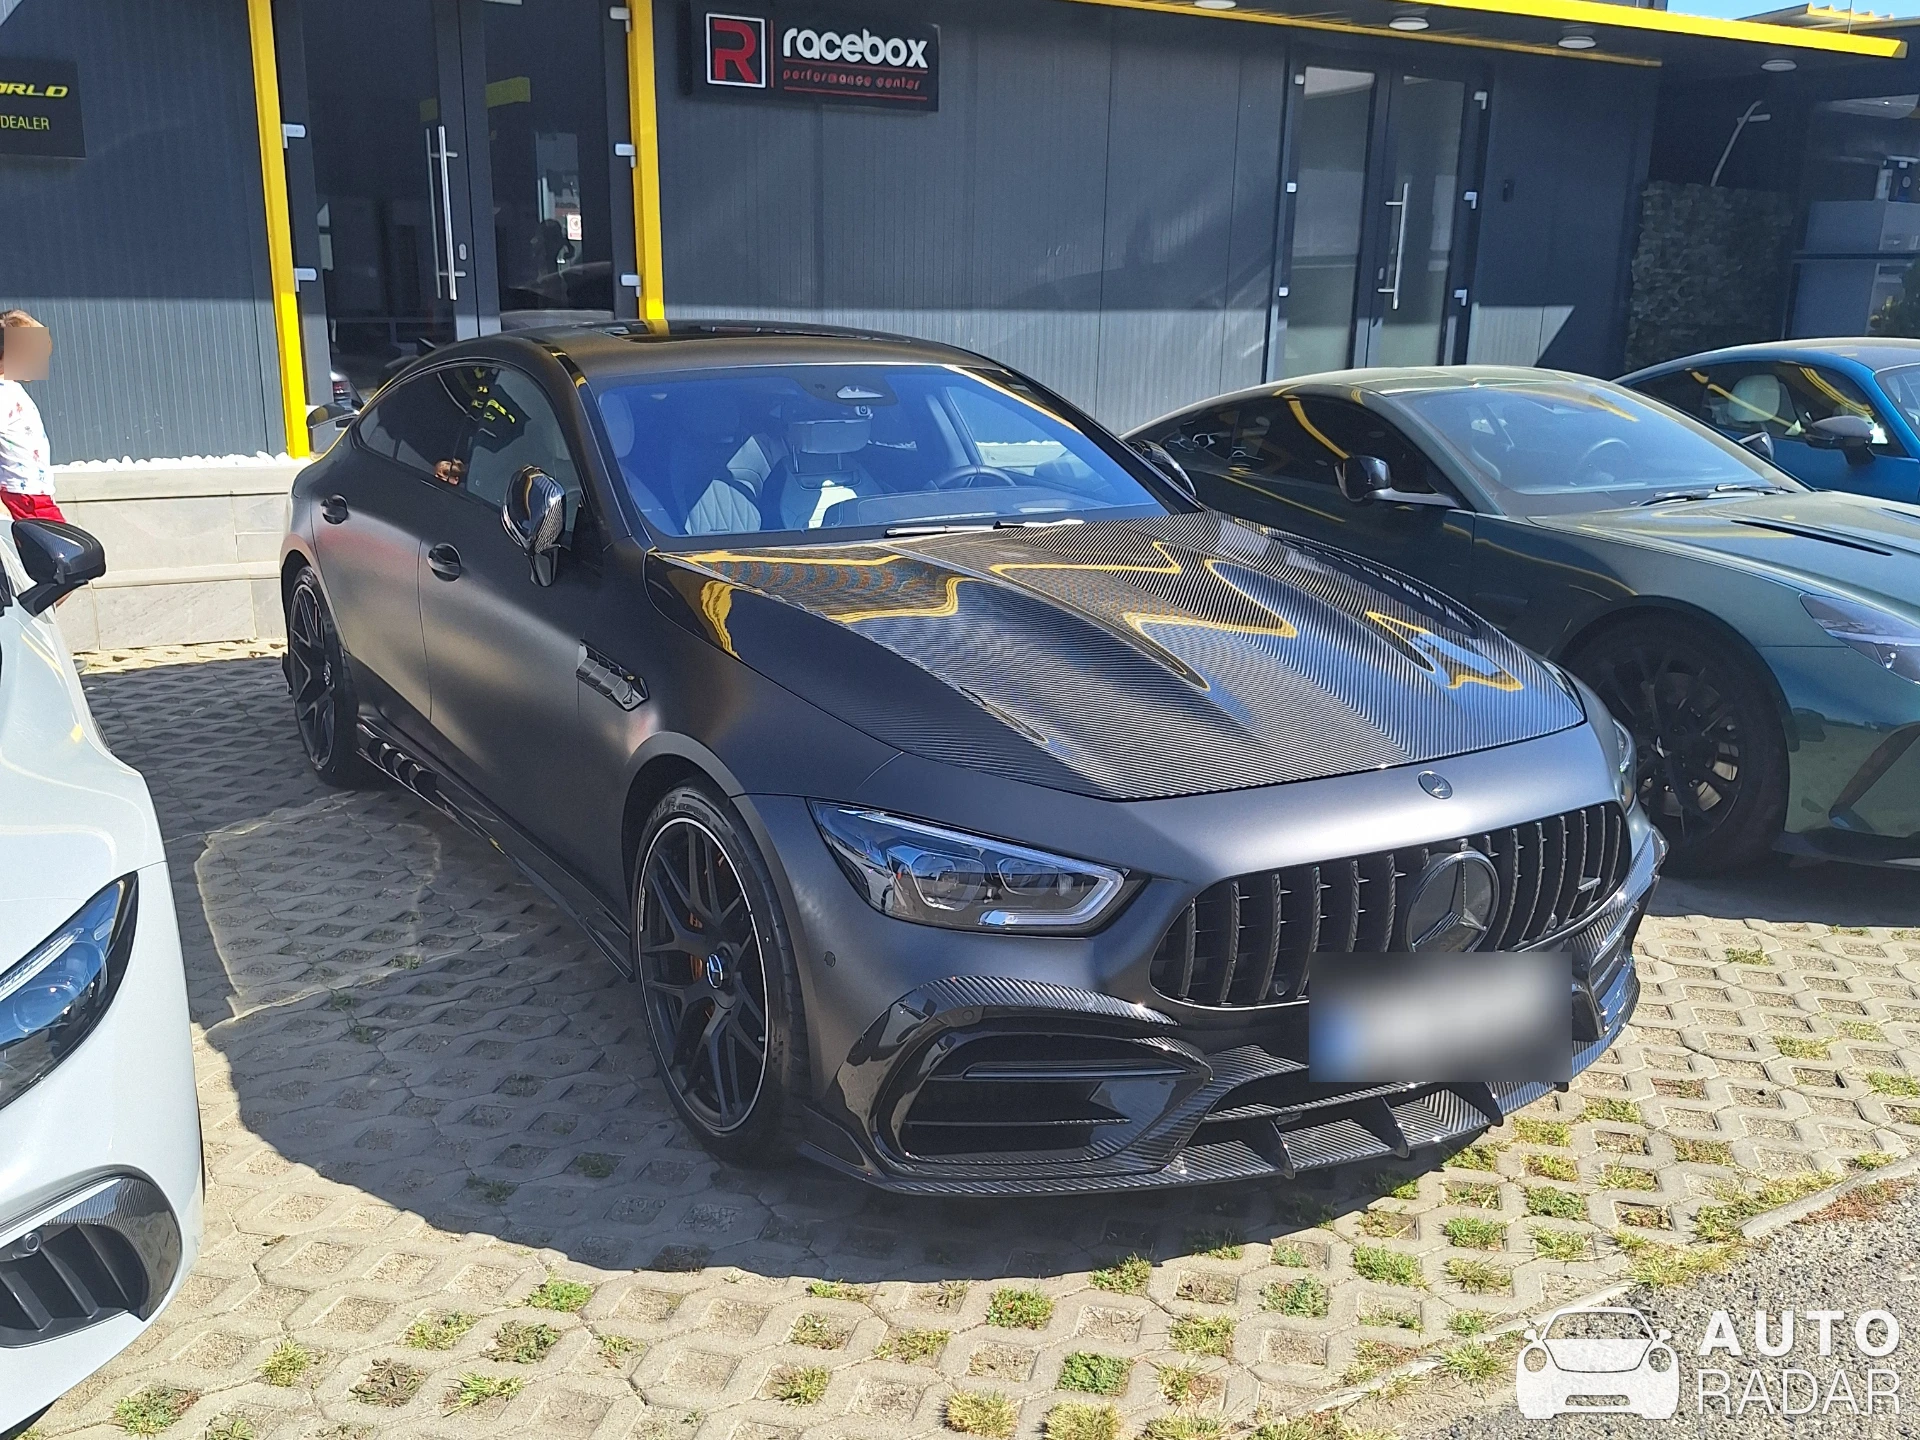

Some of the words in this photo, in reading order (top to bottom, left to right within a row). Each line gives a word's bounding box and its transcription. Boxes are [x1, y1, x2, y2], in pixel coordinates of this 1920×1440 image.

[783, 28, 928, 68] racebox
[783, 69, 872, 87] performance
[875, 77, 921, 91] center
[0, 115, 50, 130] DEALER
